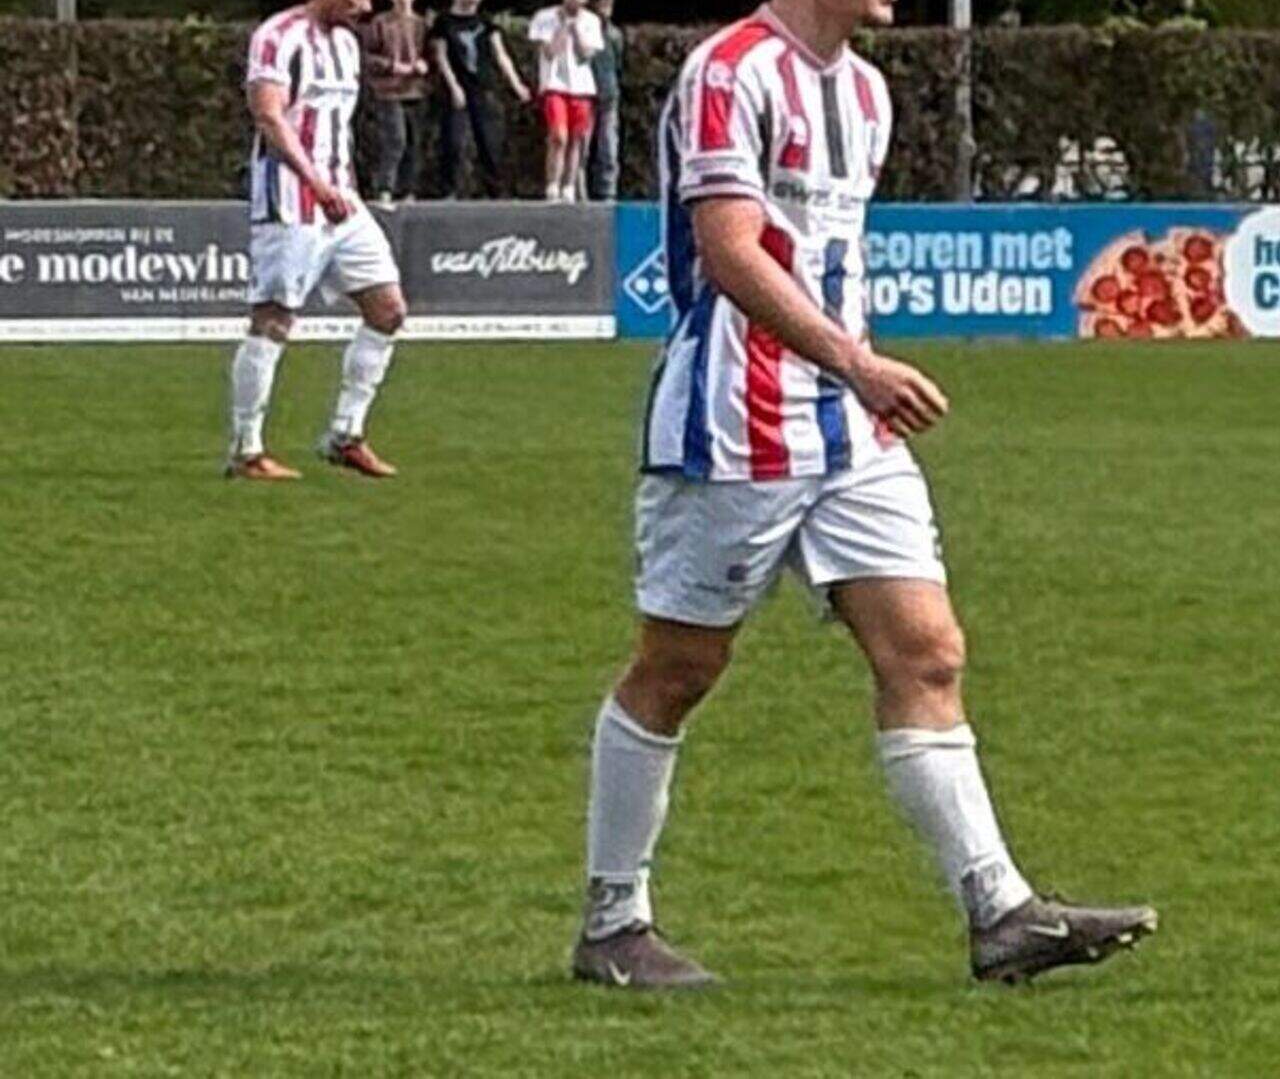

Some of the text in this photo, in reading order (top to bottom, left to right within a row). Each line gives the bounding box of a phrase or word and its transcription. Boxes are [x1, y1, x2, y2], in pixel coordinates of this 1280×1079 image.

[863, 226, 1074, 270] coren met
[941, 271, 1053, 315] Uden
